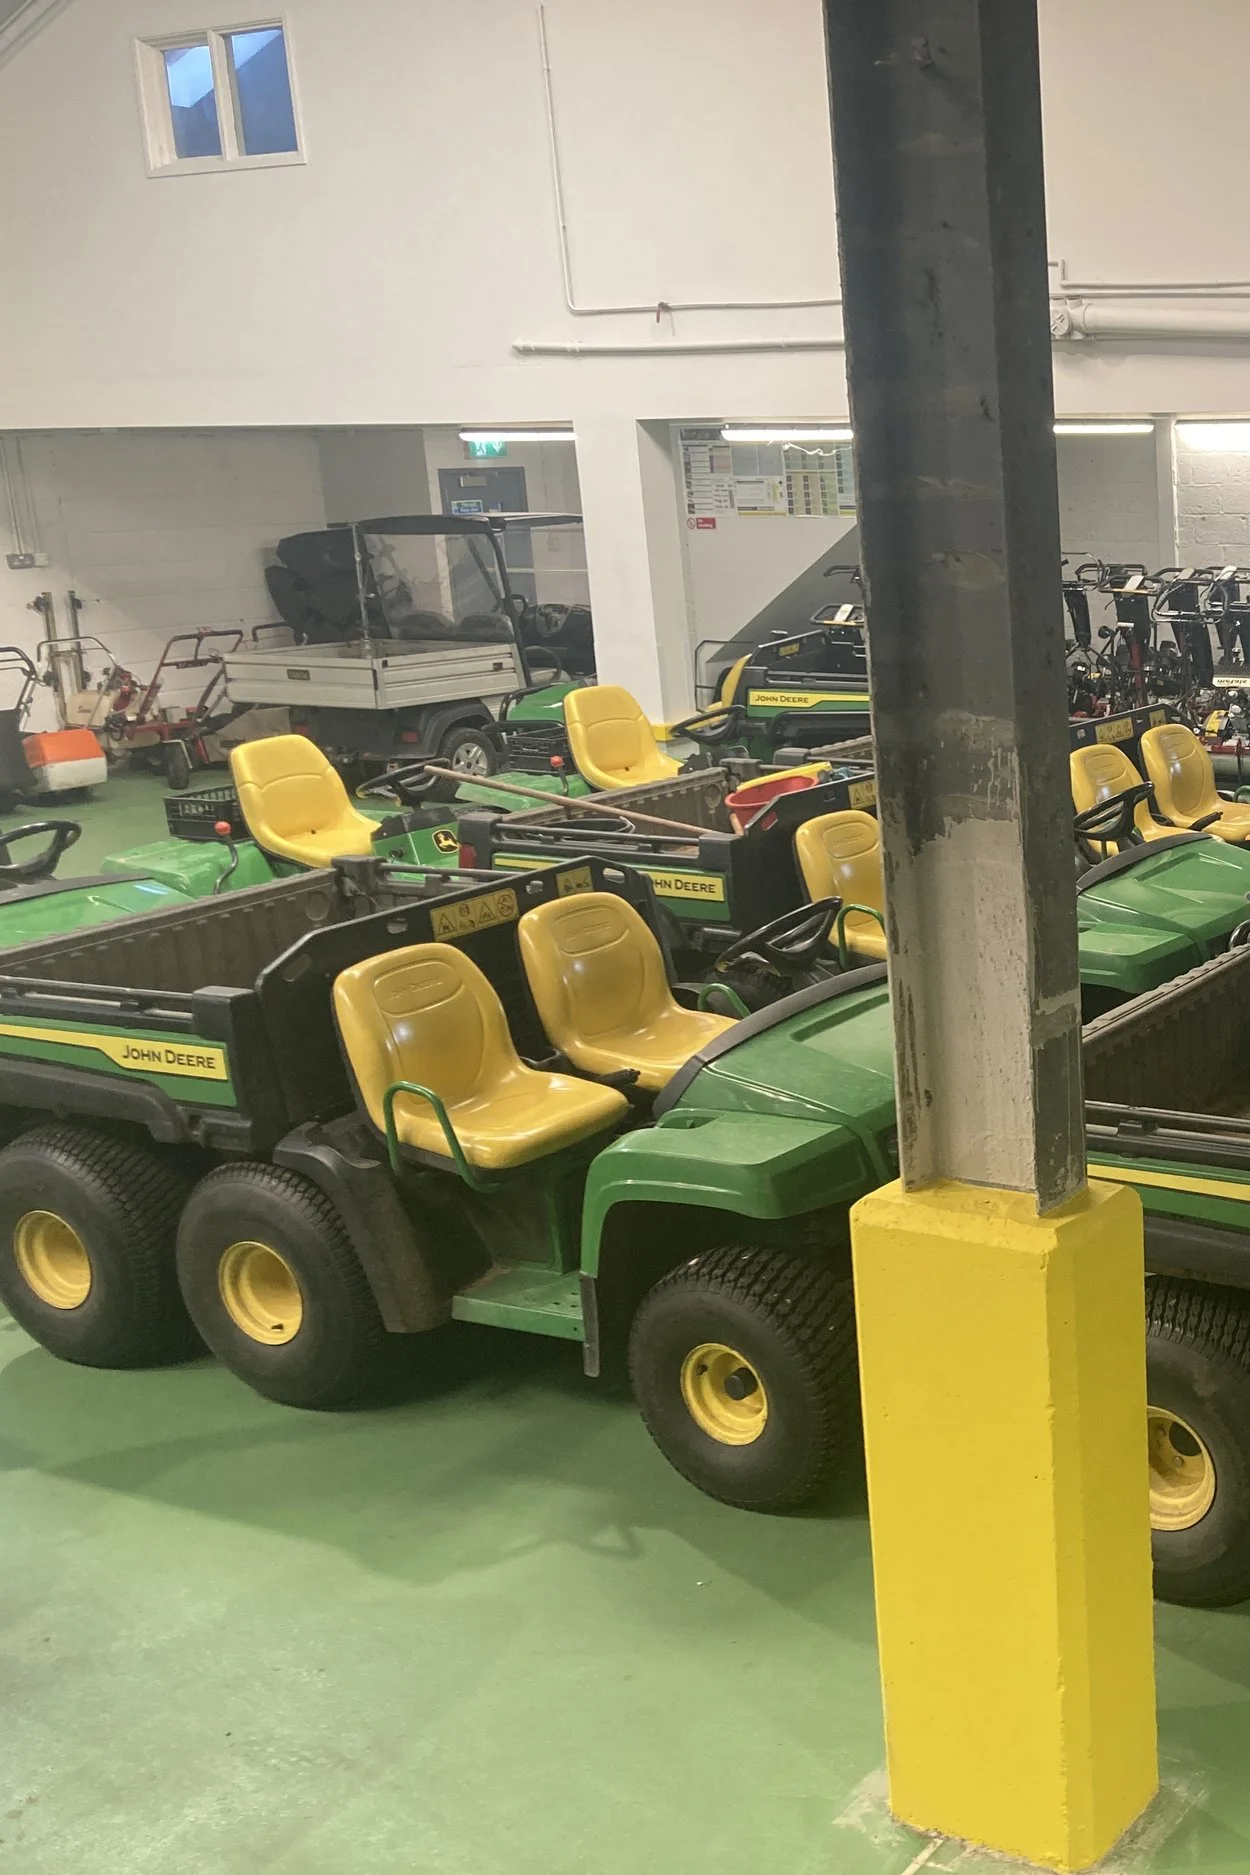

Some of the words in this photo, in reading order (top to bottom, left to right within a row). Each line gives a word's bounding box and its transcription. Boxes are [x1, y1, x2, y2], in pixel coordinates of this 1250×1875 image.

[755, 694, 778, 702] JOHN
[779, 695, 809, 703] DEERE
[655, 879, 672, 889] HN
[674, 879, 717, 893] DEERE
[122, 1044, 162, 1062] JOHN
[164, 1049, 216, 1069] DEERE
